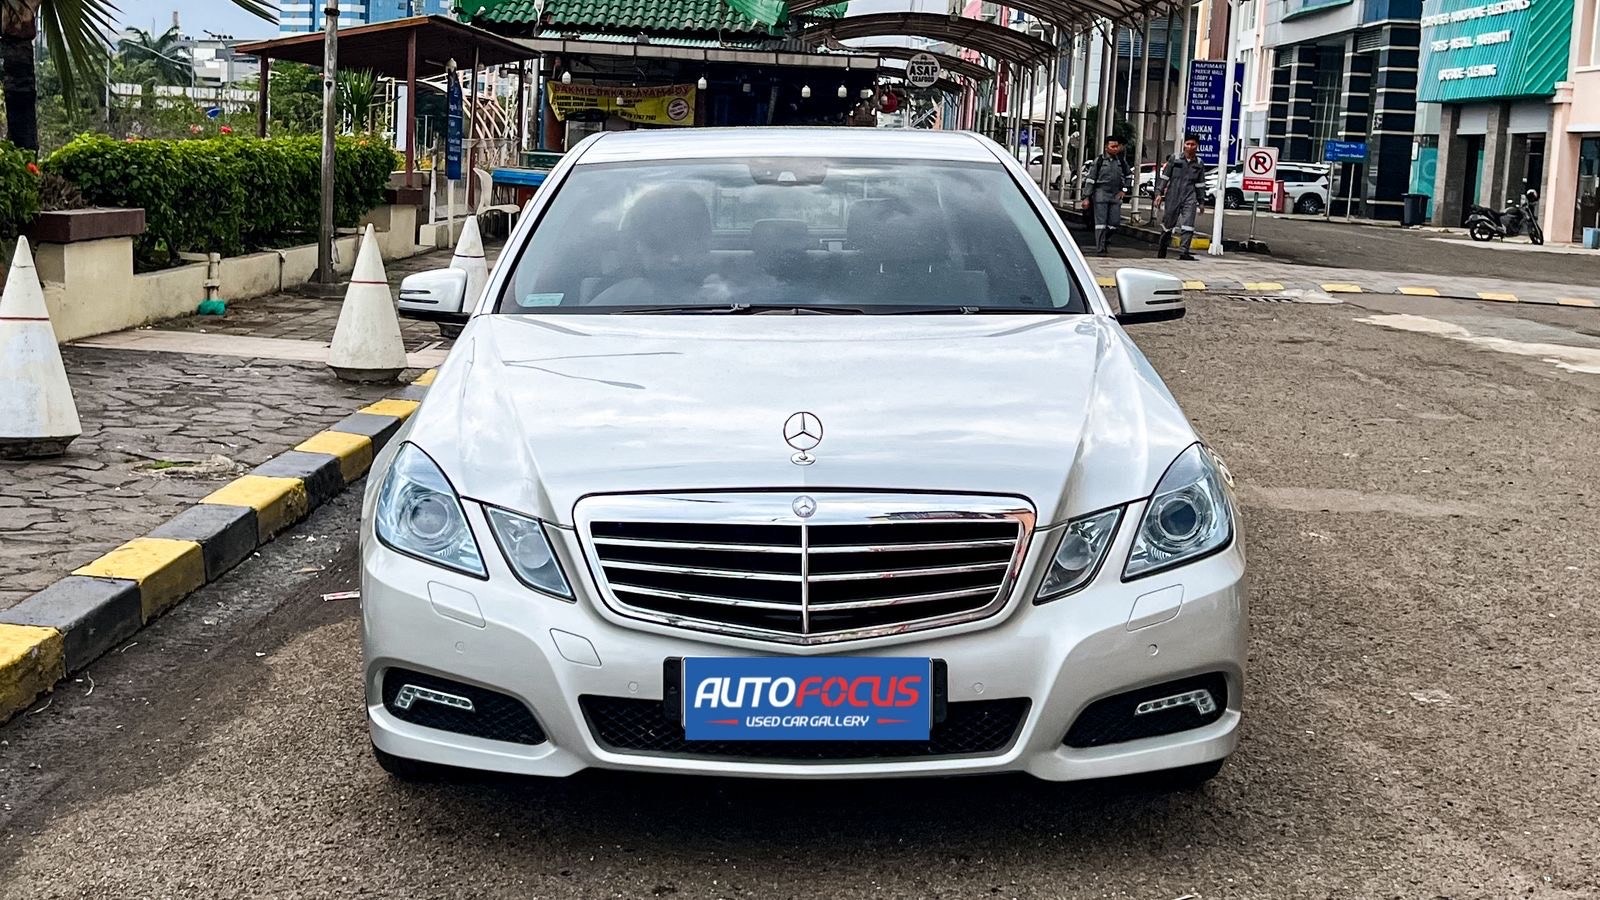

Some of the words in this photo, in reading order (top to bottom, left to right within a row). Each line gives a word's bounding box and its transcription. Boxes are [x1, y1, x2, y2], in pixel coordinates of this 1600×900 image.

[909, 66, 938, 76] ASAP
[1190, 125, 1213, 133] RUKAN
[1207, 134, 1213, 142] A
